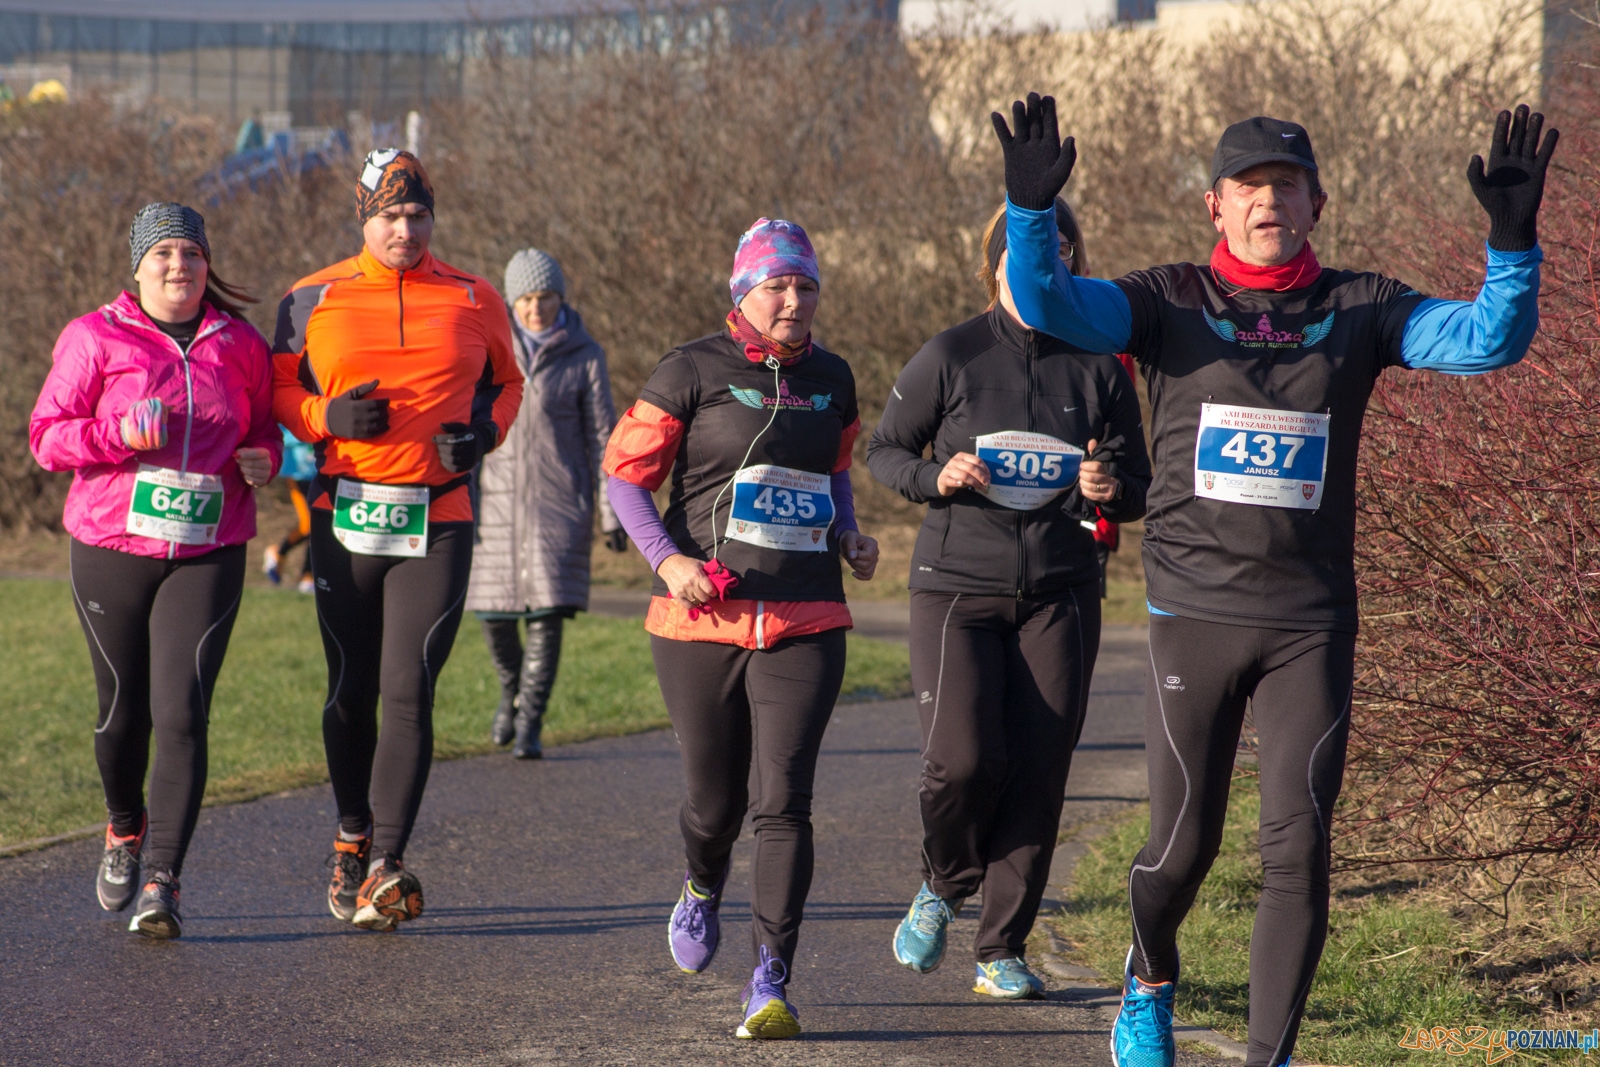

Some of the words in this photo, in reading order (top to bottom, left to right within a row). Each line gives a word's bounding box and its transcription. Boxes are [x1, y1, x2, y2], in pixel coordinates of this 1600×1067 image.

[1241, 412, 1261, 420] BIEG
[1262, 413, 1322, 425] SYLWESTROWY
[1220, 418, 1232, 426] IM.
[1234, 420, 1277, 430] RYSZARDA
[1278, 424, 1317, 434] BURGIELA
[1005, 442, 1040, 450] RYSZARDA
[1040, 445, 1074, 453] BURGIELA
[1220, 431, 1306, 469] 437
[995, 451, 1063, 481] 305
[1243, 466, 1280, 477] JANUSZ
[1015, 479, 1040, 487] IWONA
[151, 486, 211, 517] 647
[753, 486, 817, 519] 435
[165, 512, 193, 522] NATALIA
[349, 501, 409, 529] 646
[771, 516, 799, 525] DANUTA
[363, 525, 392, 533] DOMINIK
